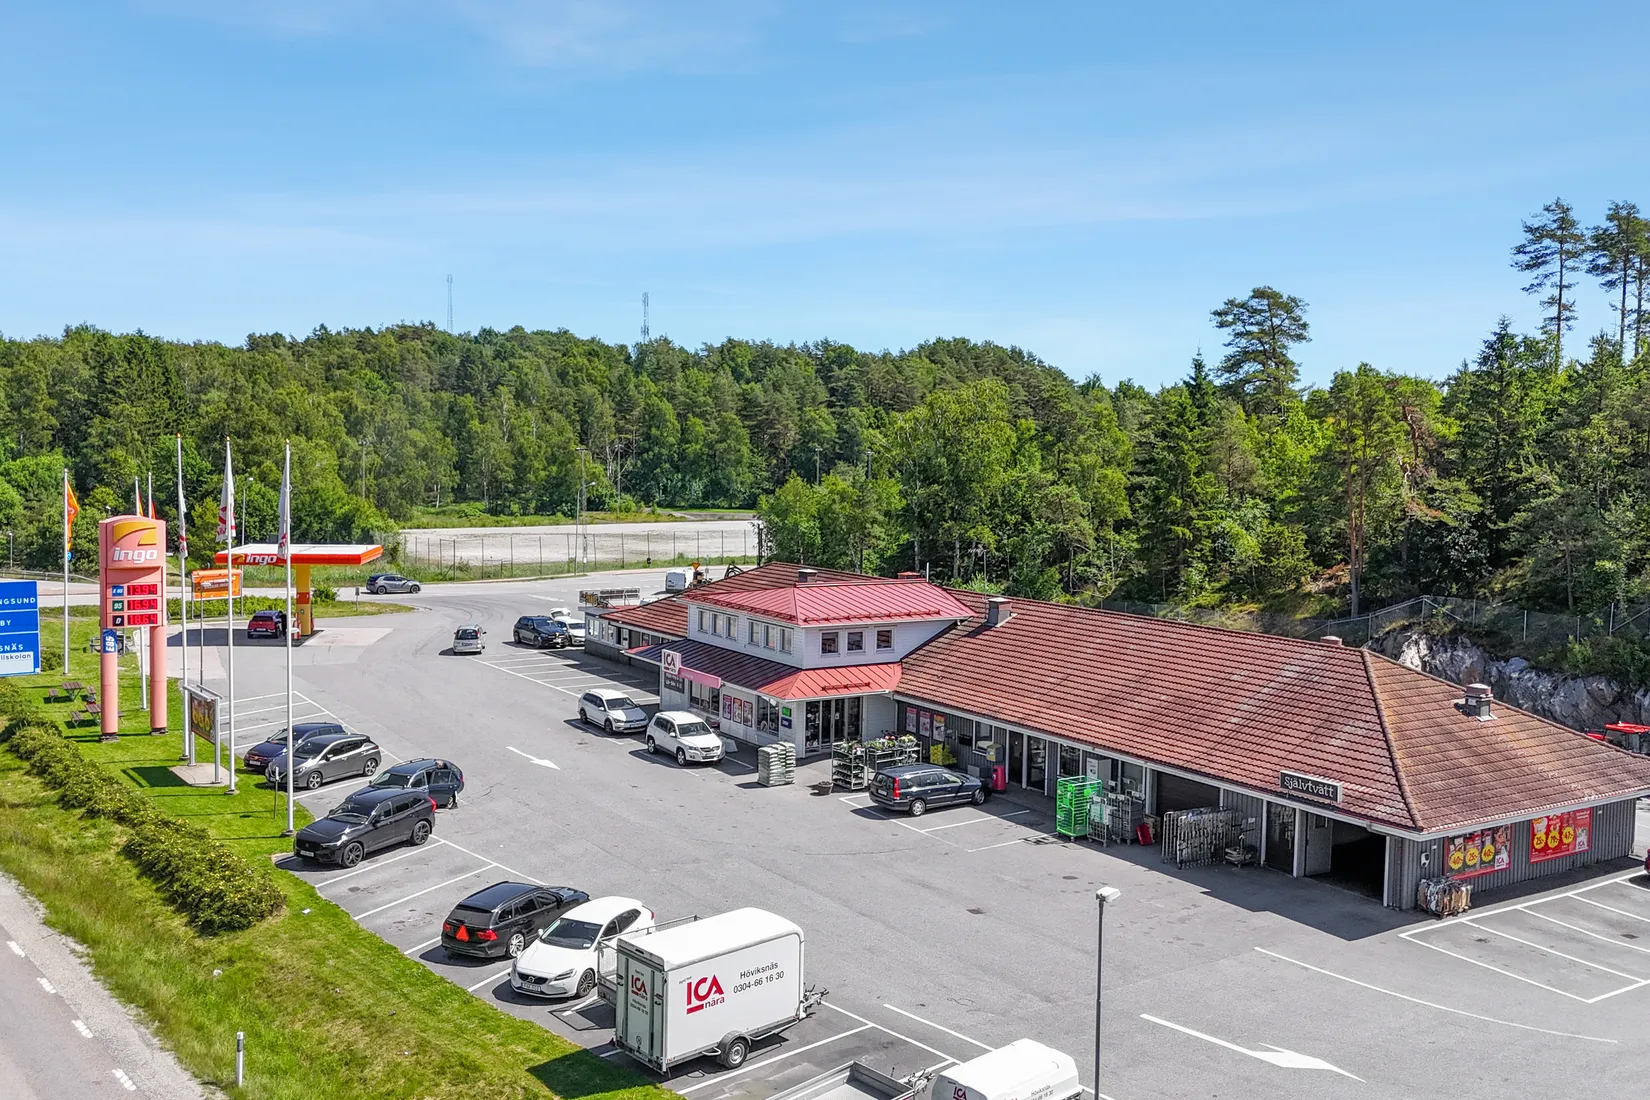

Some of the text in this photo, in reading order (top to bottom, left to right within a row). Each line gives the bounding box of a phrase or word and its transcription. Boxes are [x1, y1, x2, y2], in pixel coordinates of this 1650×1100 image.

[113, 547, 157, 564] ingo
[245, 553, 277, 565] ingo
[0, 619, 12, 627] BY
[105, 635, 115, 652] E85
[663, 652, 676, 668] ICA
[1284, 776, 1334, 798] Självtvätt
[739, 961, 779, 980] Höviksnäs
[631, 974, 648, 996] ICA
[686, 974, 725, 1006] ICA
[733, 970, 785, 994] 0304-66 16 30
[704, 996, 725, 1009] nära
[953, 1086, 967, 1100] ICA
